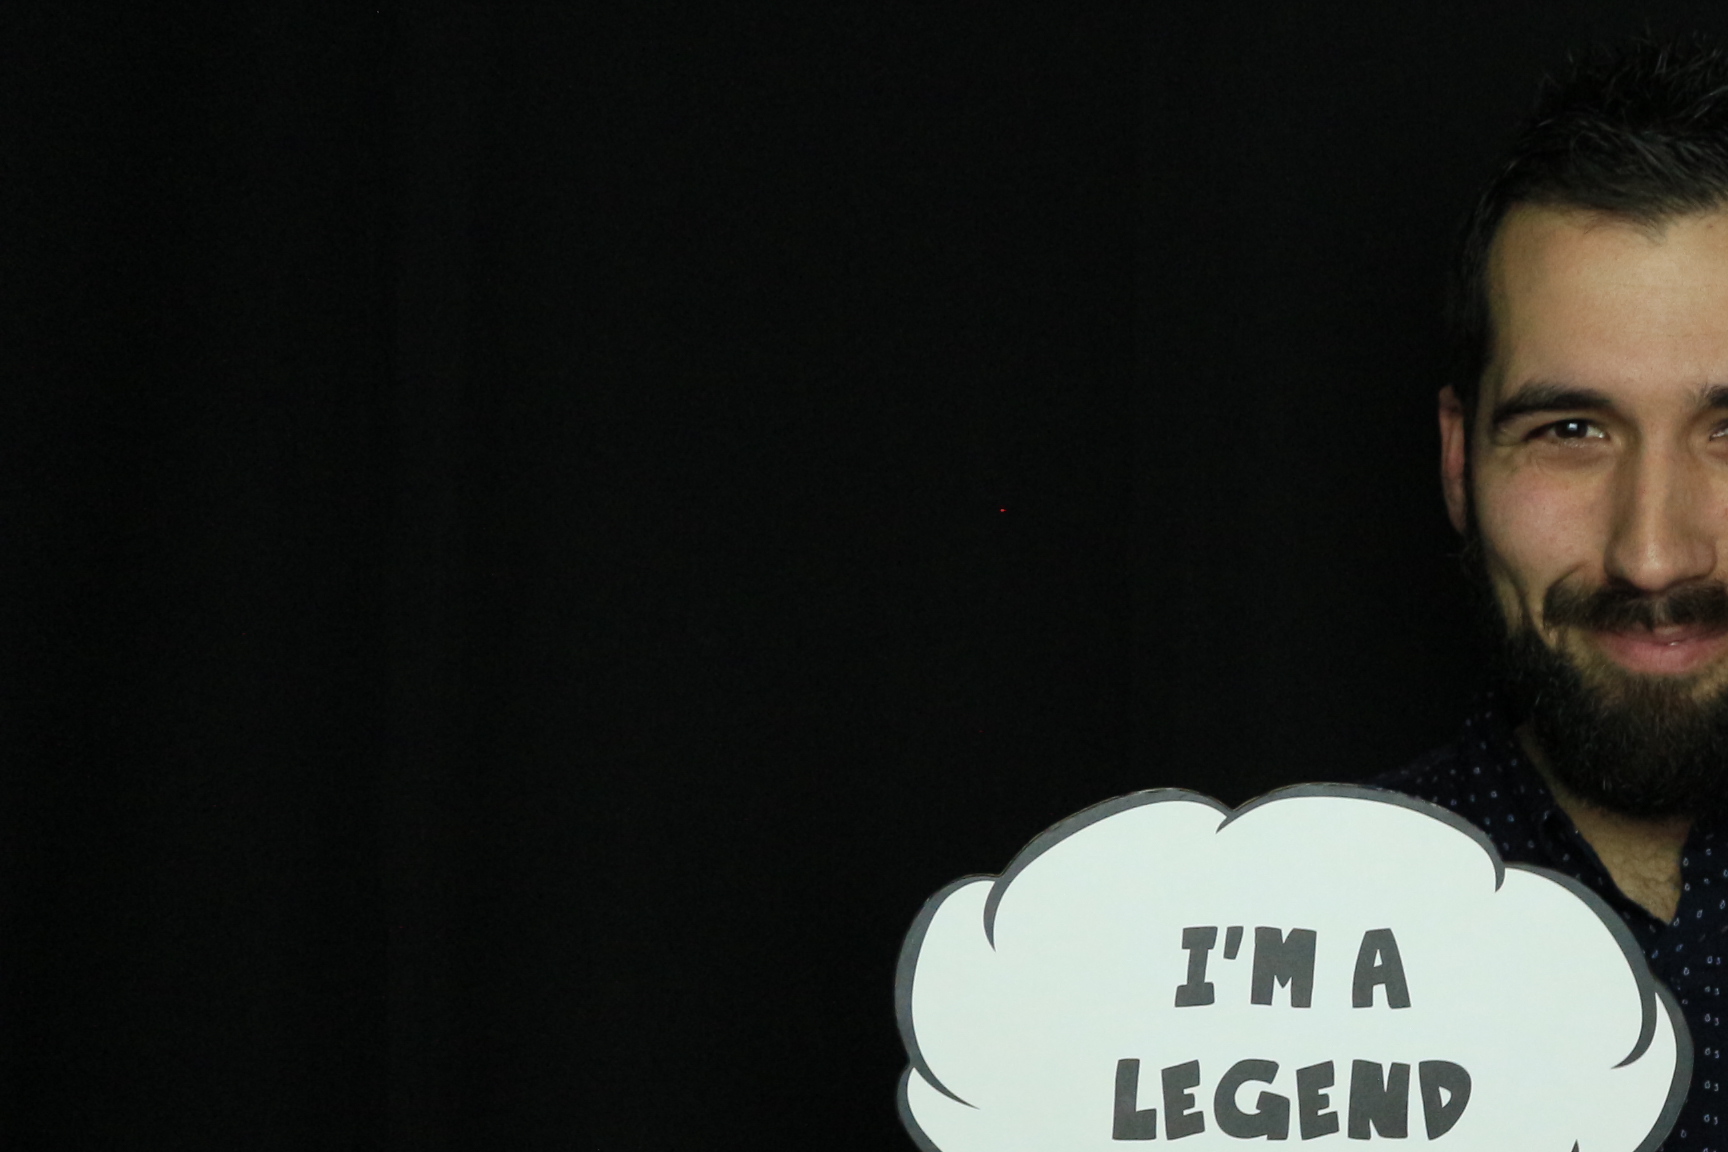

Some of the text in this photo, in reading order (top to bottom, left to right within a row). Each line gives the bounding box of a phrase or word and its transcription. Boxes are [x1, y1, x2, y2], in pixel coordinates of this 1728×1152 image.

[1174, 925, 1412, 1010] I'M A
[1111, 1057, 1473, 1142] LEGEND
